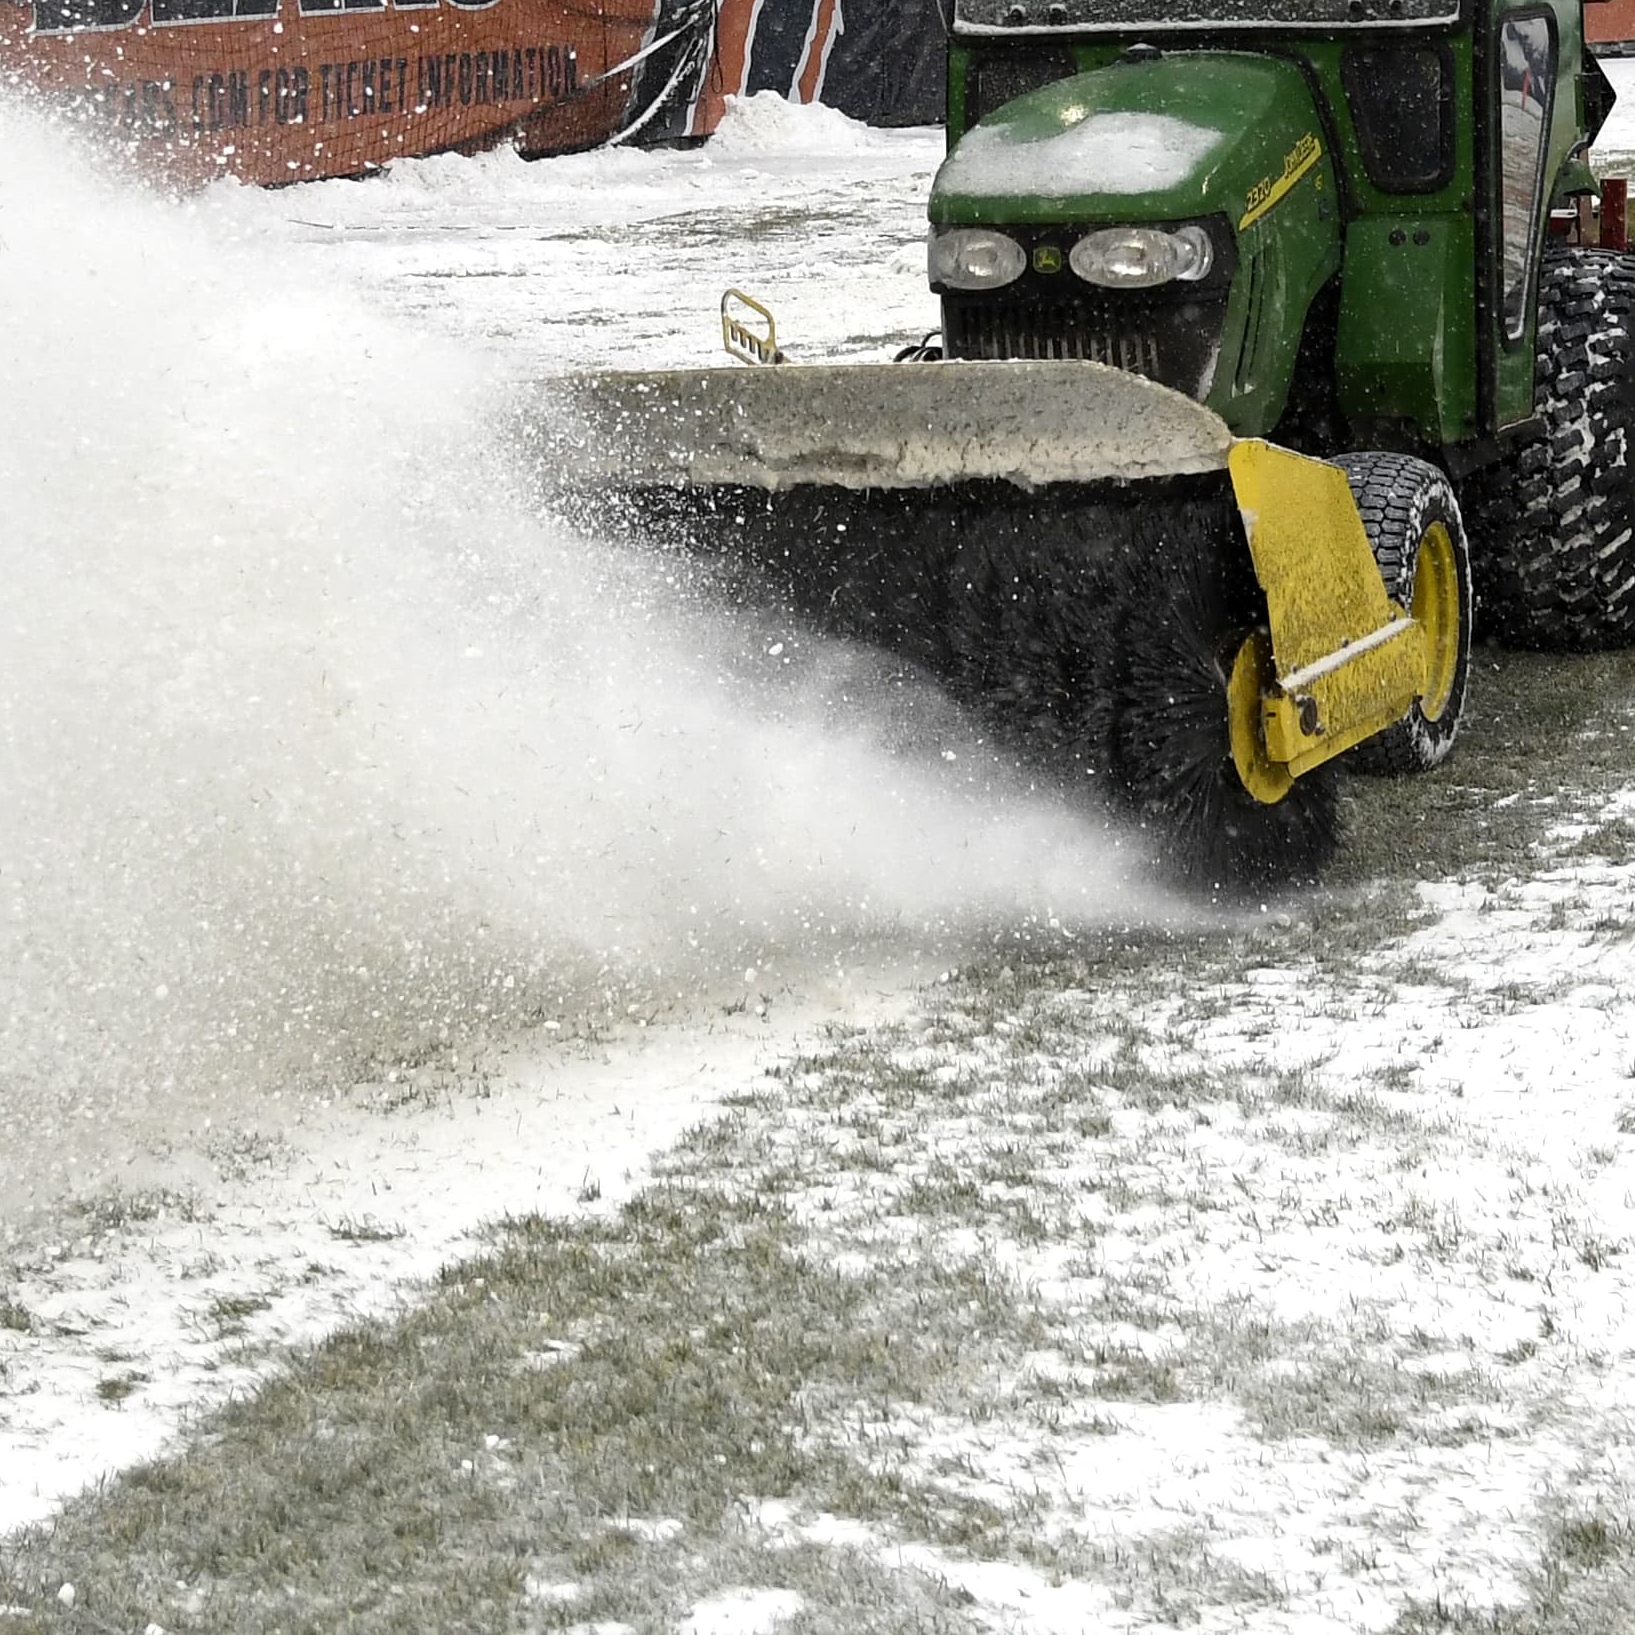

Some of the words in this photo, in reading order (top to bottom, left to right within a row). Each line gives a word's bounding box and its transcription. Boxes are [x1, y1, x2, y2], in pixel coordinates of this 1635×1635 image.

[318, 56, 408, 126] TICKET
[418, 43, 578, 110] INFORMATION
[1246, 176, 1271, 211] 2320
